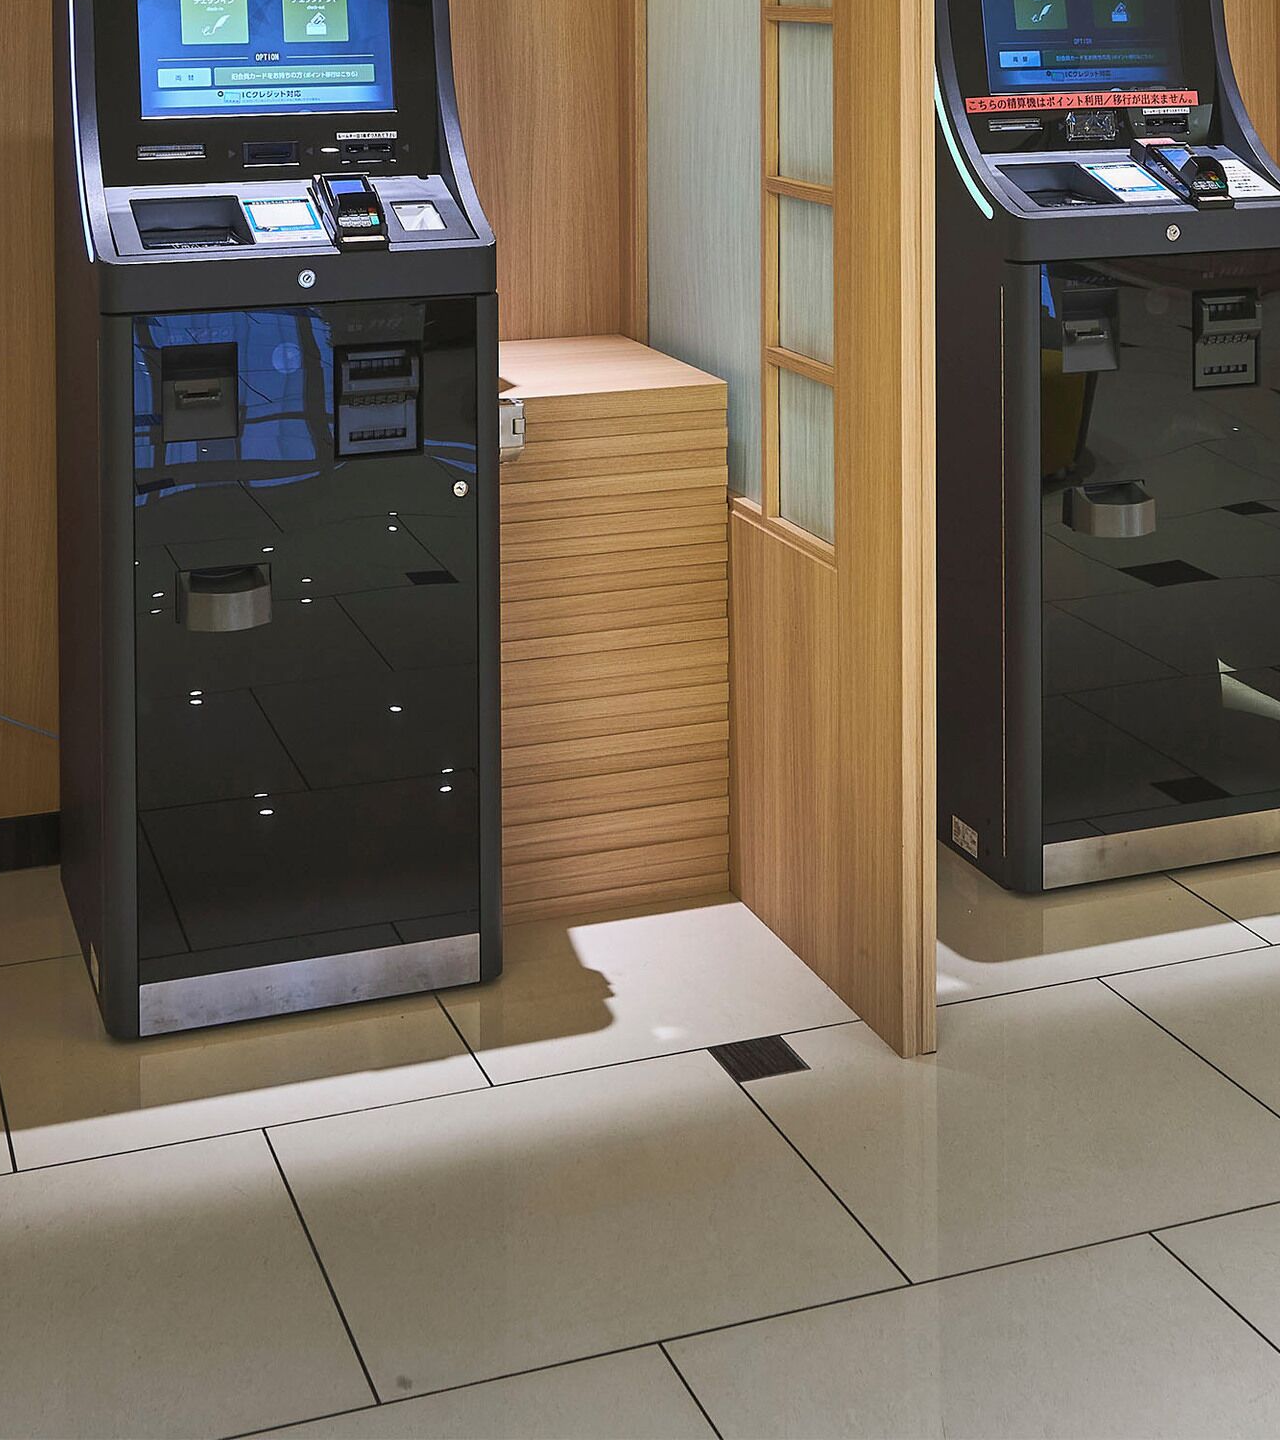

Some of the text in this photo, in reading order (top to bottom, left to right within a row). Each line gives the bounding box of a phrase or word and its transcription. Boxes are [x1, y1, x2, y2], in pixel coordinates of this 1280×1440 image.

[255, 53, 280, 61] OPTION
[241, 90, 302, 99] ICクレジット対応
[968, 92, 1194, 111] こちらの精算機はポイント利用／移行が出来ません。
